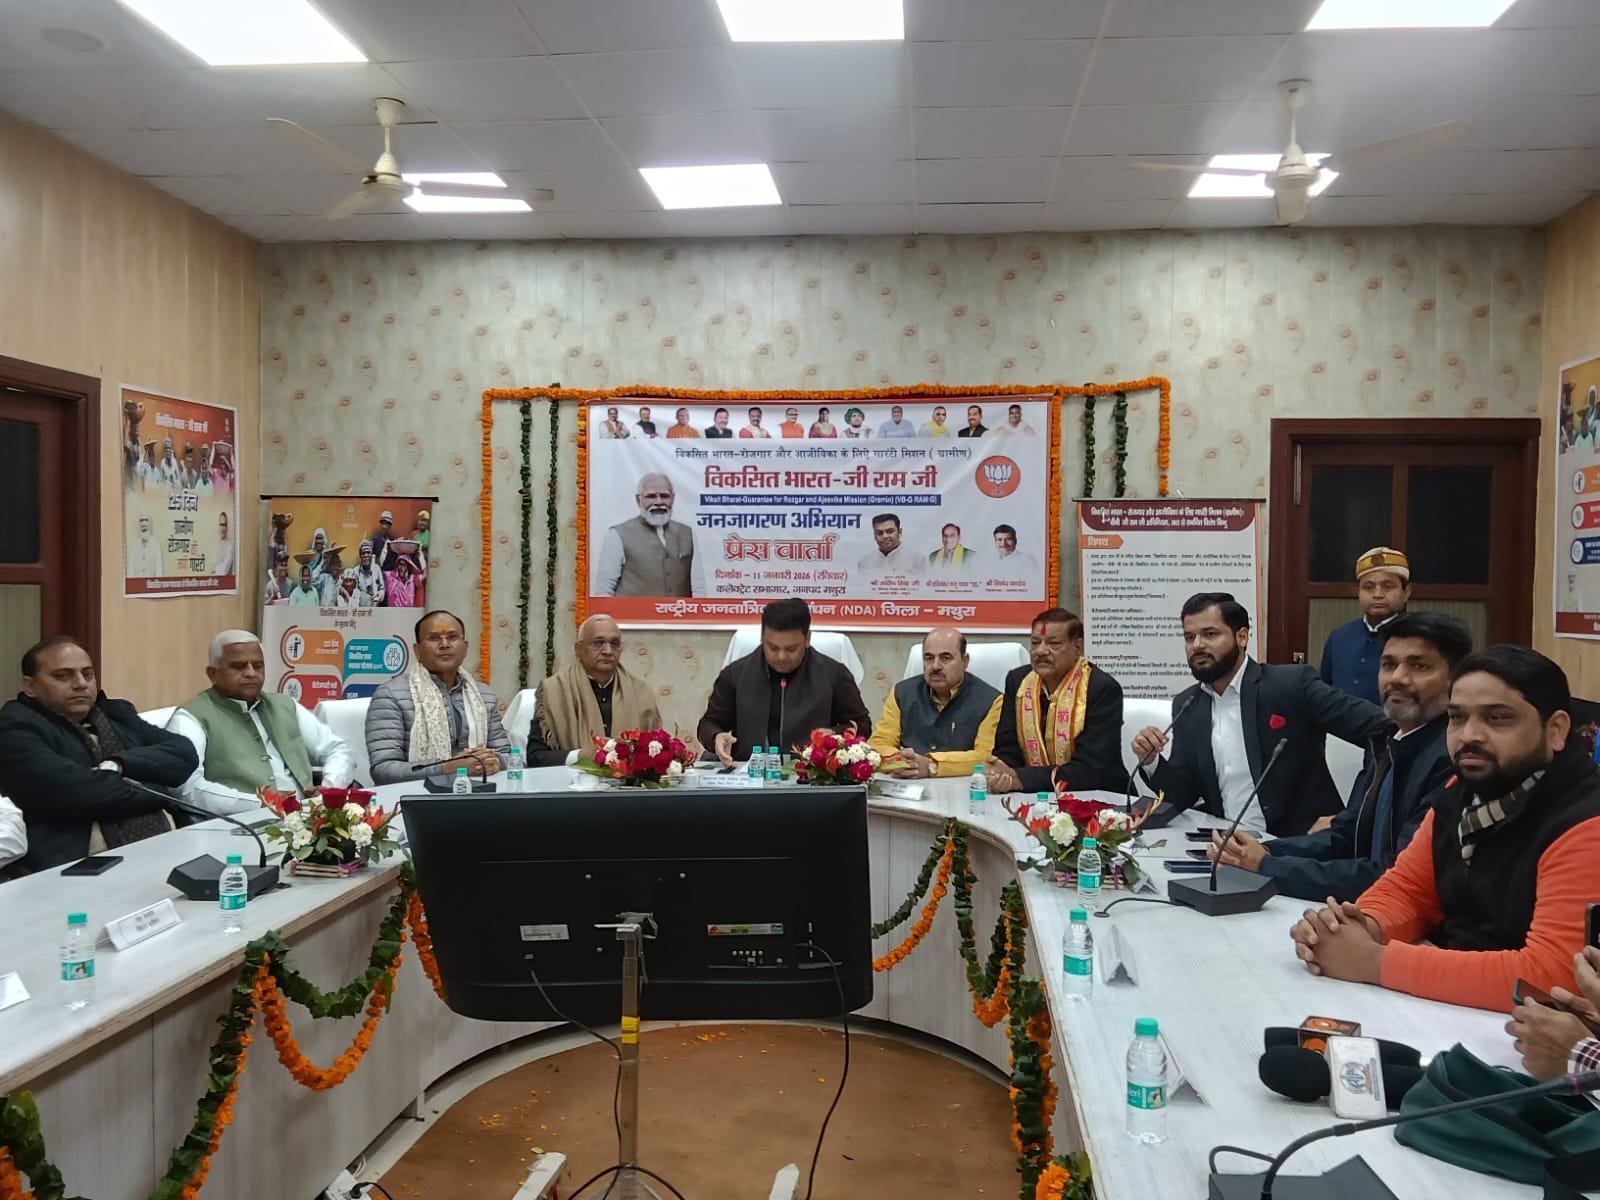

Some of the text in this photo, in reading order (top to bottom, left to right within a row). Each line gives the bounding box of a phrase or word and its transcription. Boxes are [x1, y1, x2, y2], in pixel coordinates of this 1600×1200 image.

[675, 447, 708, 458] विकसित
[775, 445, 792, 459] और
[795, 447, 838, 459] आजीविका
[840, 447, 849, 458] के
[874, 446, 898, 458] गारंटी
[901, 447, 926, 458] मिशन
[704, 465, 781, 488] विकसित
[873, 470, 907, 488] राम
[911, 464, 938, 488] जी
[844, 496, 867, 504] Mission
[696, 508, 862, 528] जनजागरण अभियान
[723, 532, 840, 562] प्रेस वार्ता
[714, 568, 742, 580] दिनांक
[753, 571, 761, 580] 11
[763, 569, 792, 580] जनवरी
[794, 571, 810, 580] 2026
[813, 569, 848, 582] (रविवार)
[792, 585, 821, 595] जनपद
[823, 585, 846, 597] मथुरा
[655, 600, 698, 618] राष्ट्रीय
[840, 604, 876, 617] (NDA)
[880, 601, 920, 616] जिला
[937, 604, 977, 620] मथुरा
